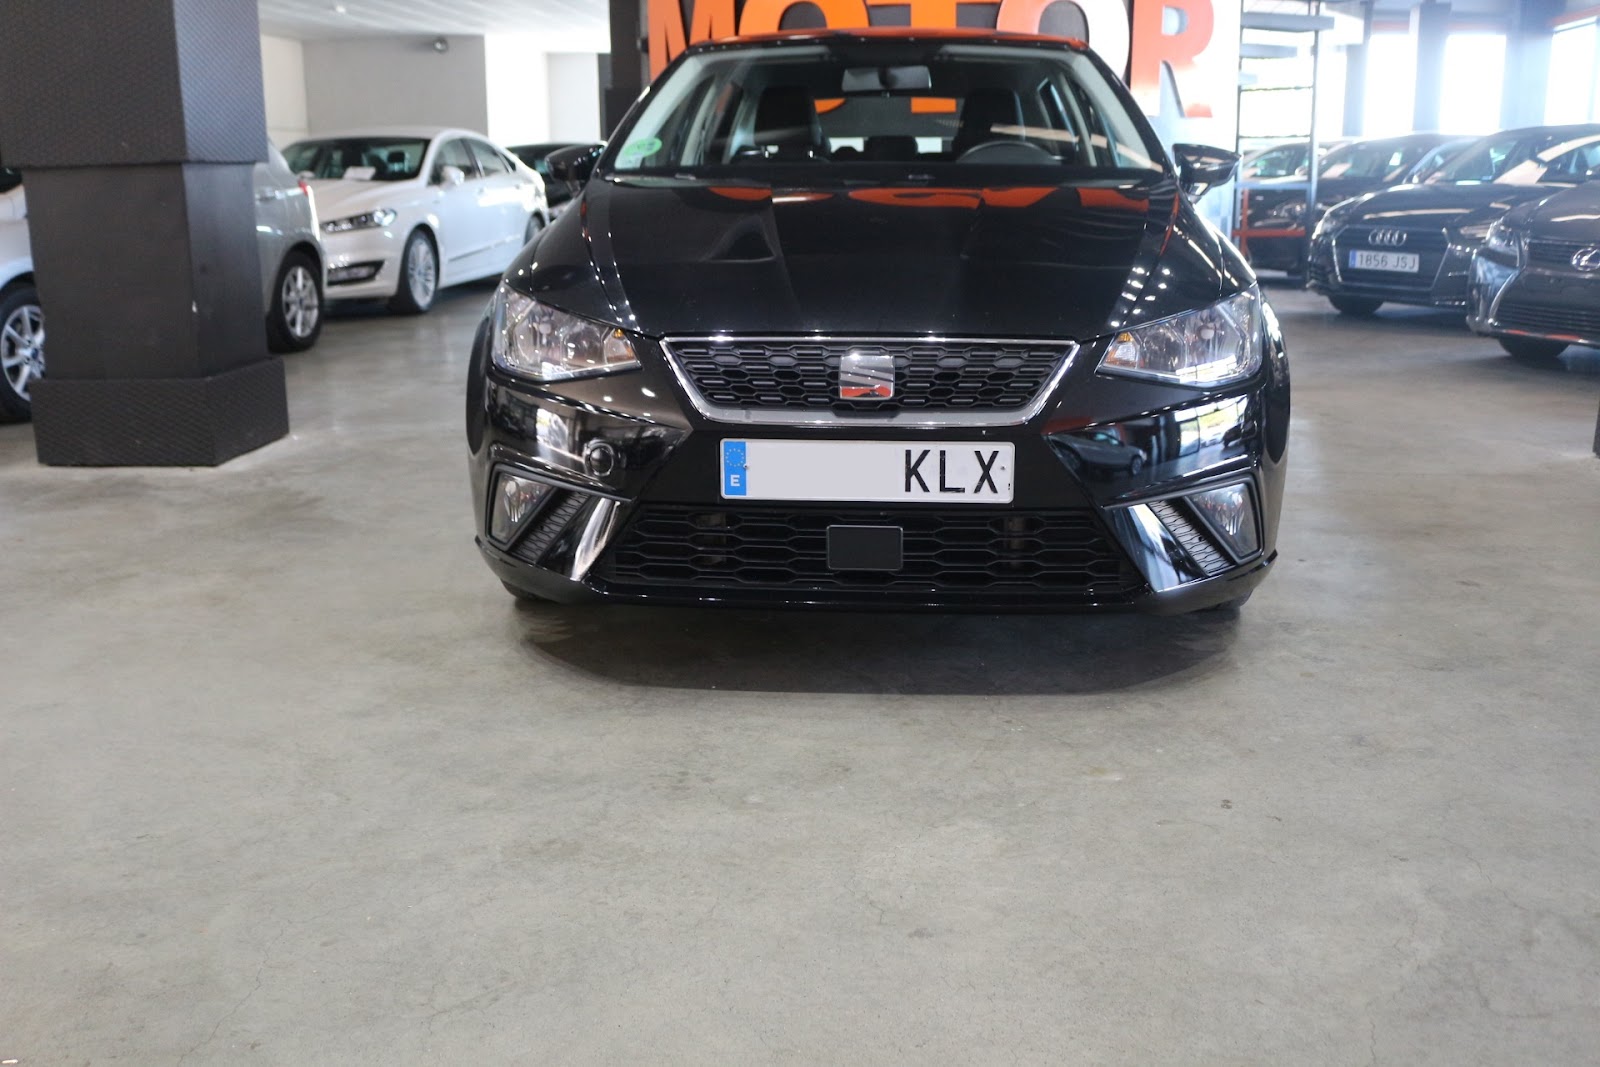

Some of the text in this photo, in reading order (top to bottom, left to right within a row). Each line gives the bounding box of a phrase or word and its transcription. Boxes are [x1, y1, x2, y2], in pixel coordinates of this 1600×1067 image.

[648, 0, 1214, 117] MOR
[1359, 253, 1416, 269] 1856 JSJ
[730, 474, 741, 487] E
[904, 449, 999, 493] KLX
